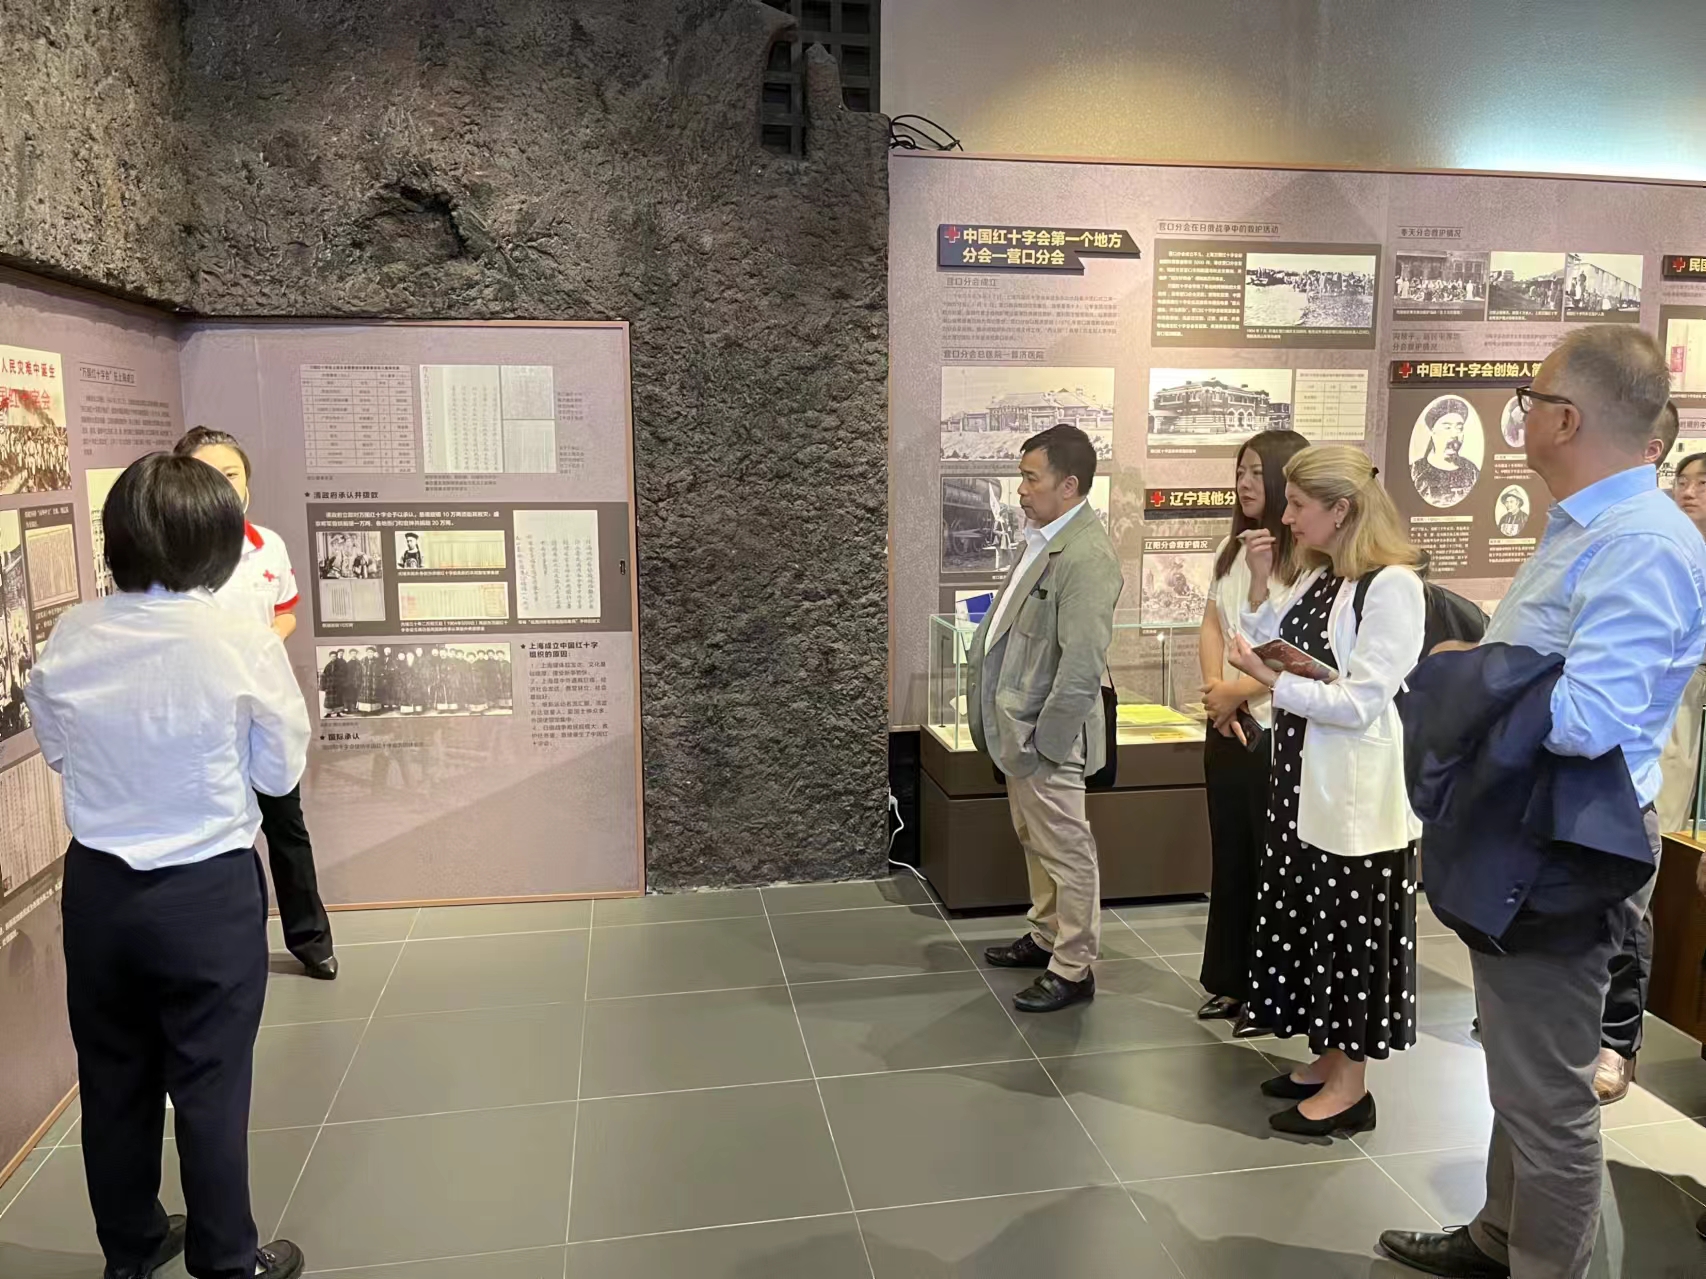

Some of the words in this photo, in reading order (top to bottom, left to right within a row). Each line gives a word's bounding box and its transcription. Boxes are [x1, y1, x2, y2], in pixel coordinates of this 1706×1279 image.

[963, 227, 1122, 248] 中国红十字会第一个地方
[1169, 491, 1237, 506] 辽宁其他分
[1145, 539, 1208, 550] 辽阳分会救护情况
[529, 641, 599, 650] 上海成立中国红十字
[328, 733, 360, 741] 国际承认
